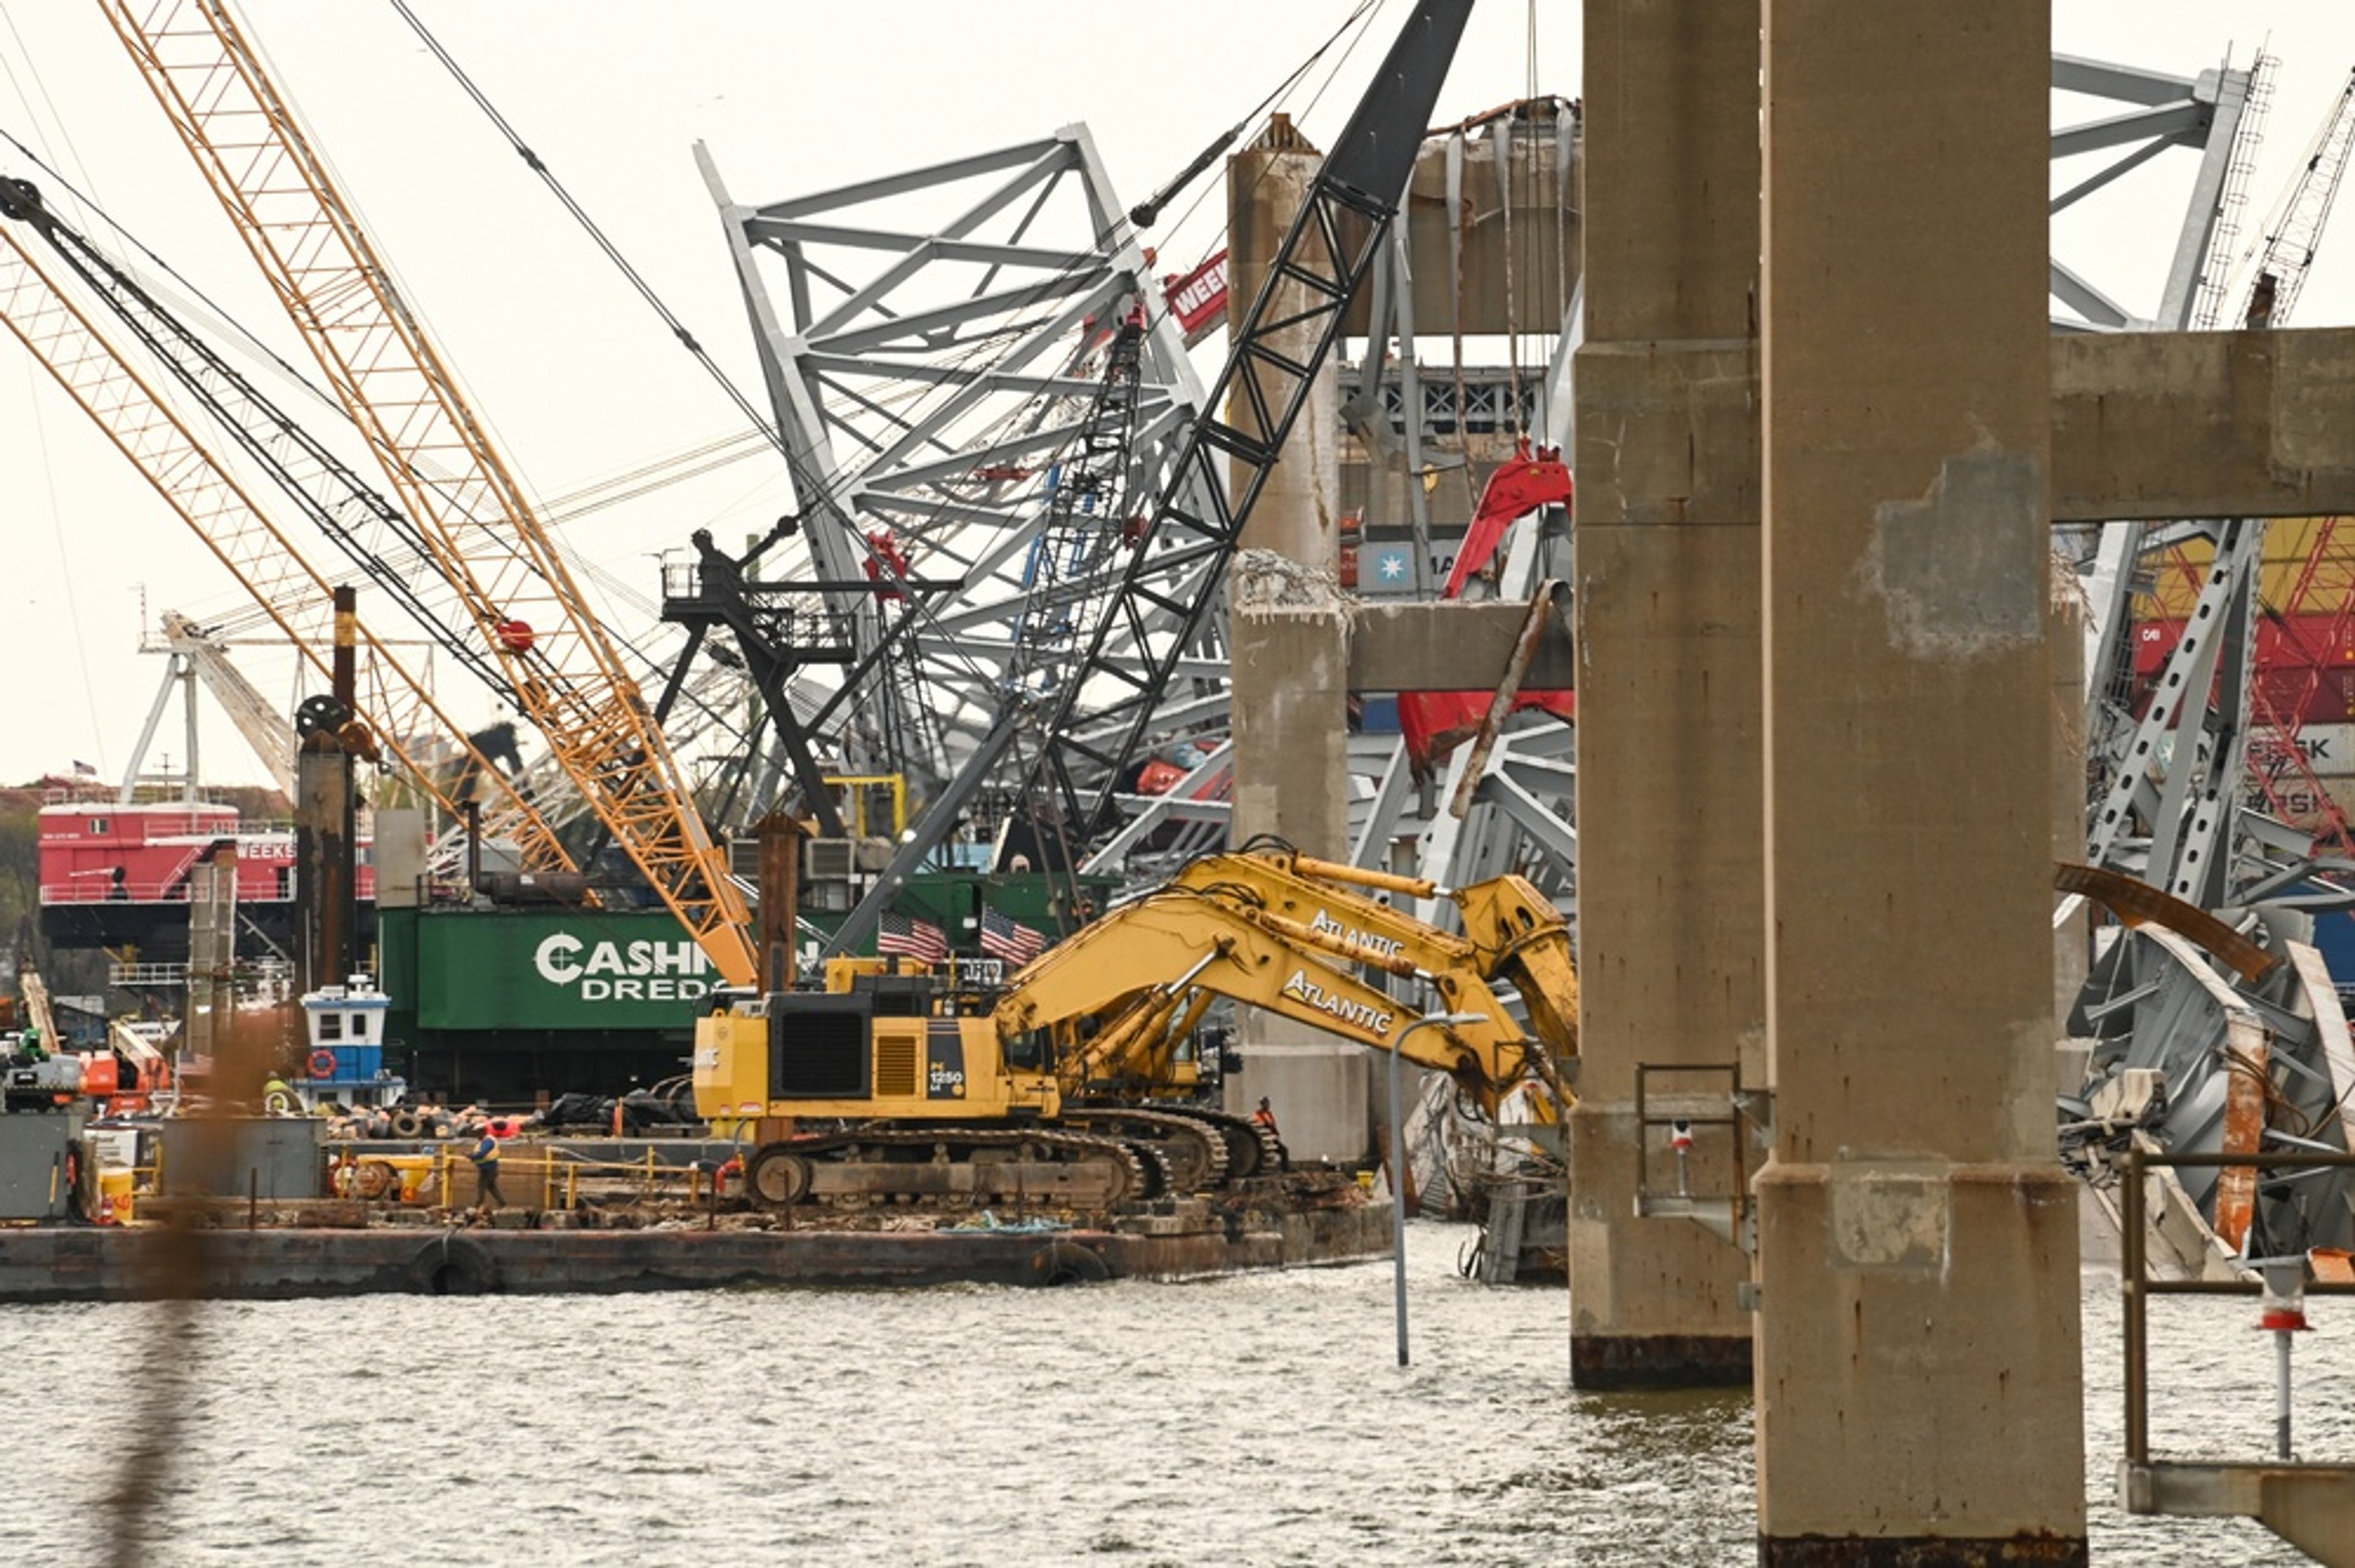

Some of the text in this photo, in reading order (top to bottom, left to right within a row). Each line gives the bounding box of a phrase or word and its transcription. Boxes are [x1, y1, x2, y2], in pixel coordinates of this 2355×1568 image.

[236, 844, 297, 858] WEEKS
[581, 979, 730, 1000] DRED
[1283, 970, 1392, 1033] ATLANTIC
